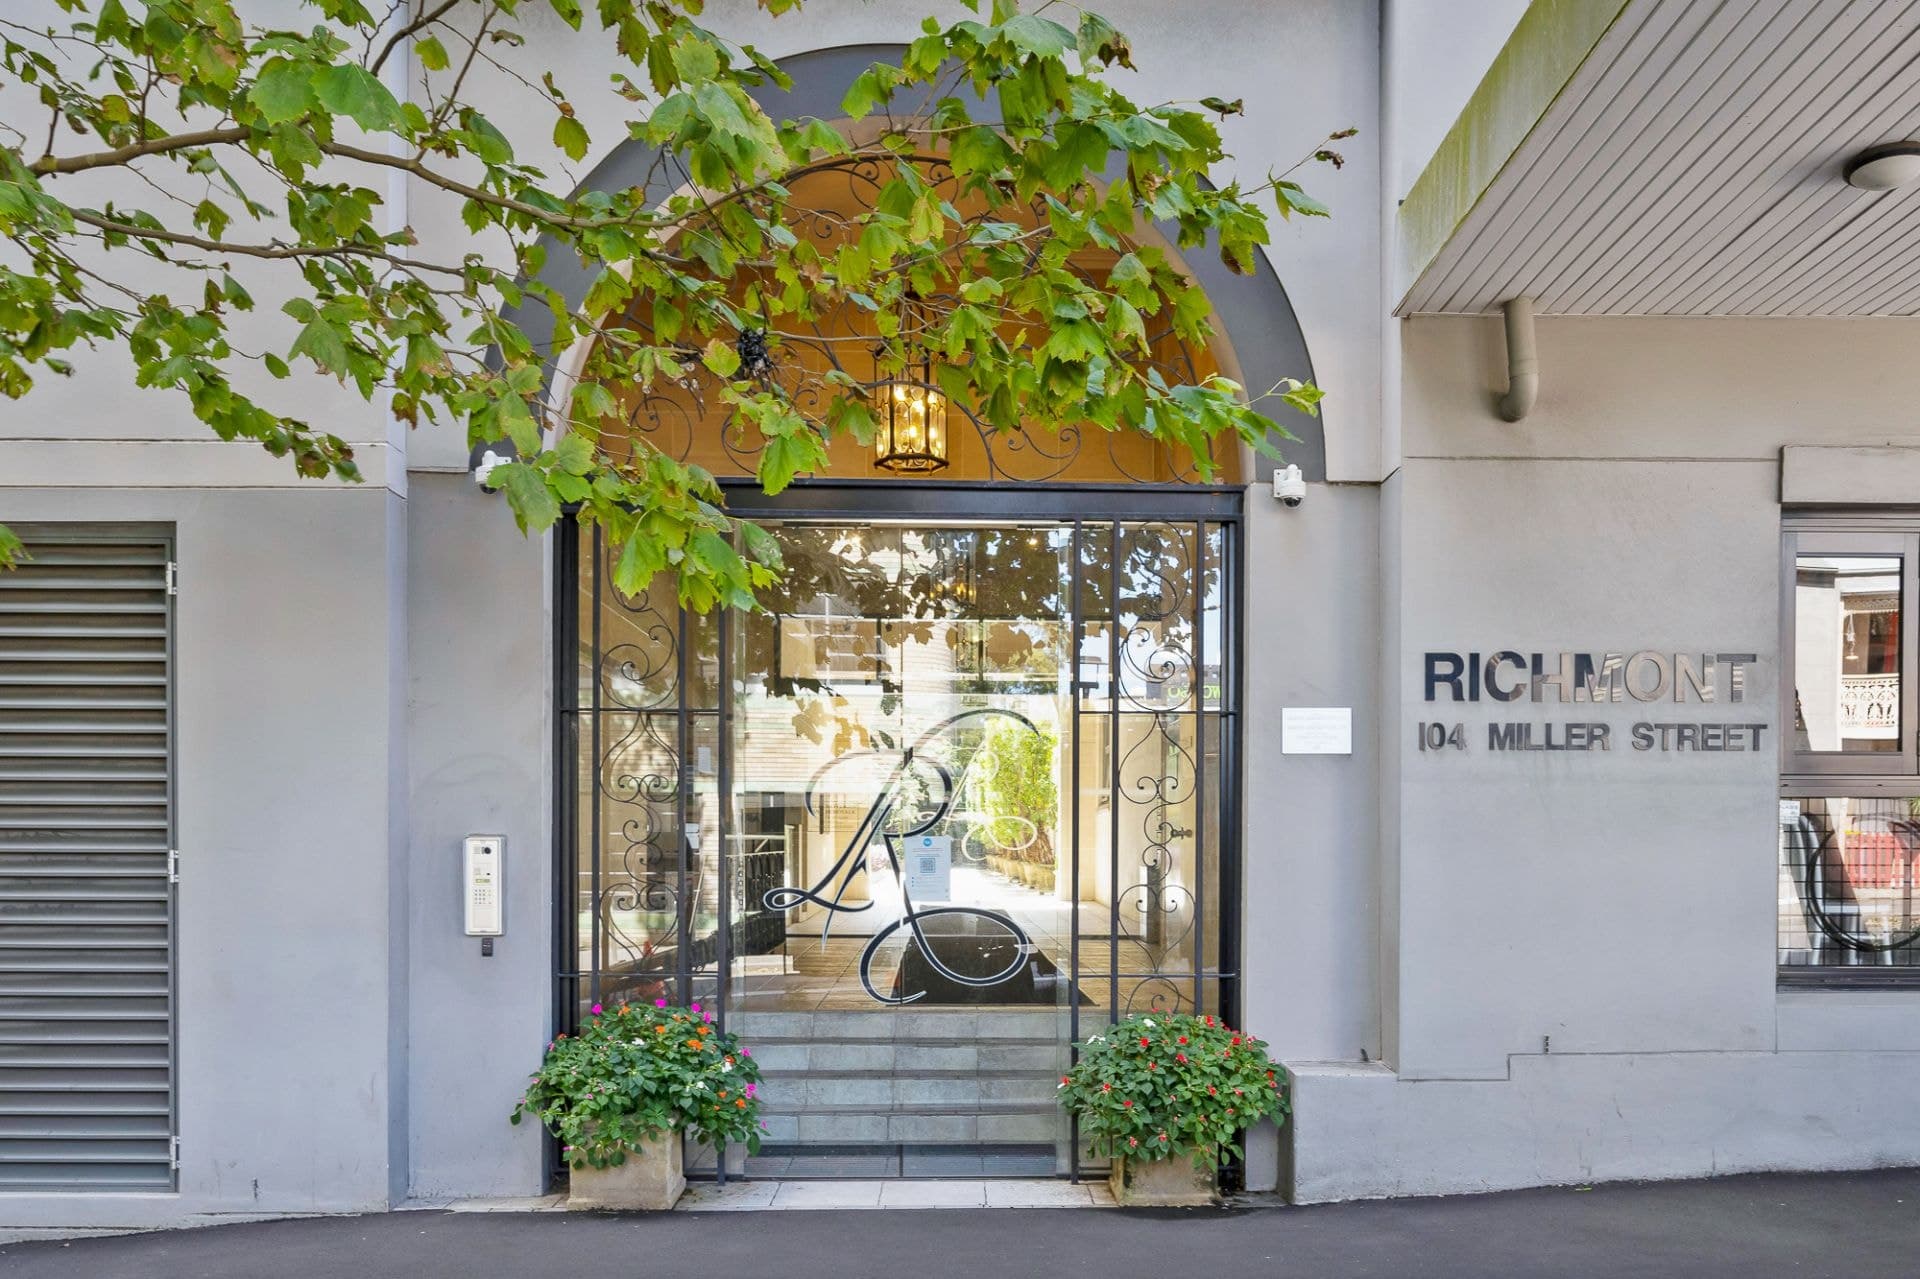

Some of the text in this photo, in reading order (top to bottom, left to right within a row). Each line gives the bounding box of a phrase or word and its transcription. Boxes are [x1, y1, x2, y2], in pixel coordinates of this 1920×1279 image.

[1424, 650, 1757, 703] RICHMONT
[1418, 721, 1768, 752] 104 MILLER STREET
